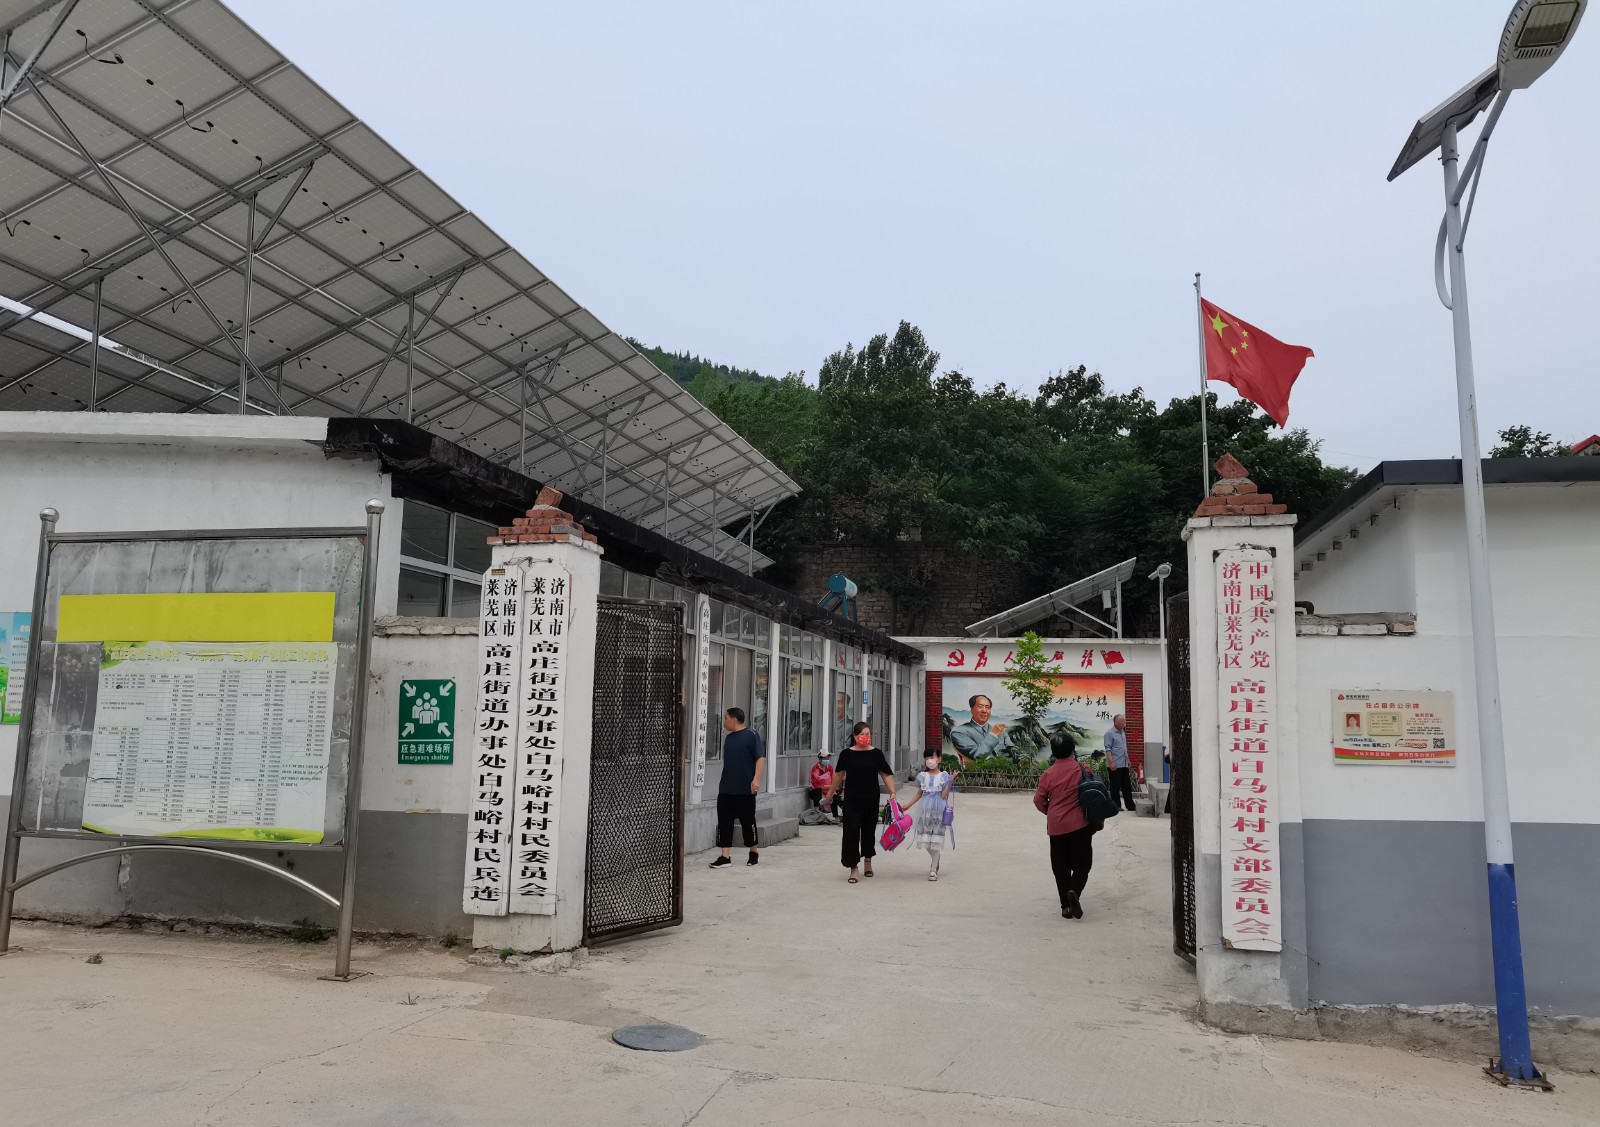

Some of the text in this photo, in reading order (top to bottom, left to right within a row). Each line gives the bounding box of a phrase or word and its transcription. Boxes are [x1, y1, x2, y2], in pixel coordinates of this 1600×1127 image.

[484, 578, 500, 637] 莱芜区
[503, 578, 518, 637] 济南市
[529, 577, 546, 636] 莱芜区
[549, 577, 566, 636] 济南市
[1221, 561, 1243, 669] 济南市莱芜区
[1248, 561, 1271, 669] 中国共产党
[400, 743, 451, 754] 应急避难场所
[401, 754, 430, 762] Emergency
[469, 643, 513, 903] 高庄街道办事处白马峪村民兵连
[519, 640, 560, 898] 高庄街道办事处白马峪村村民委员会
[1227, 677, 1274, 936] 高庄街道白马峪村支部委员会
